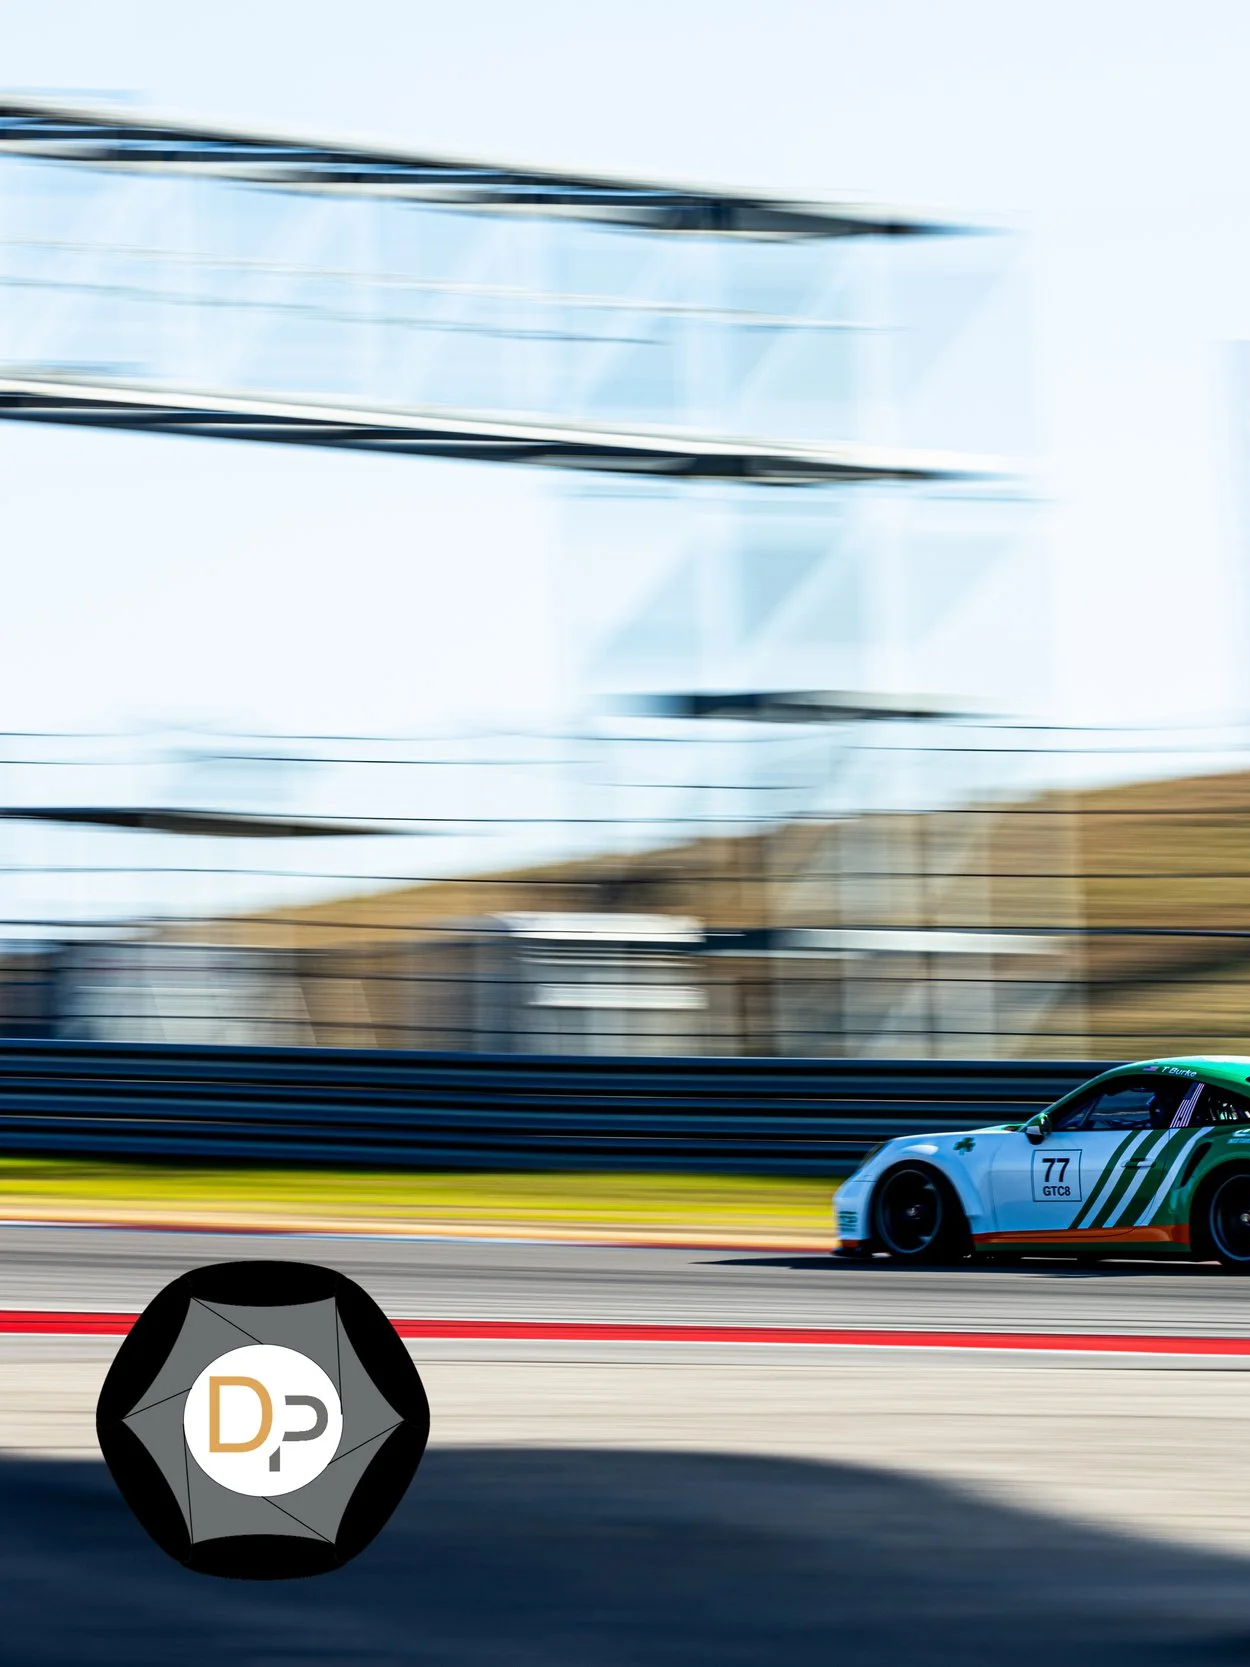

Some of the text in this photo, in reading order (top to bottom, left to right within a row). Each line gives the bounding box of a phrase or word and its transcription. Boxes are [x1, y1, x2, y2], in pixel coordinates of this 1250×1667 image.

[1168, 1067, 1197, 1077] Burke
[1042, 1158, 1070, 1183] 77
[1043, 1185, 1071, 1196] GTC8
